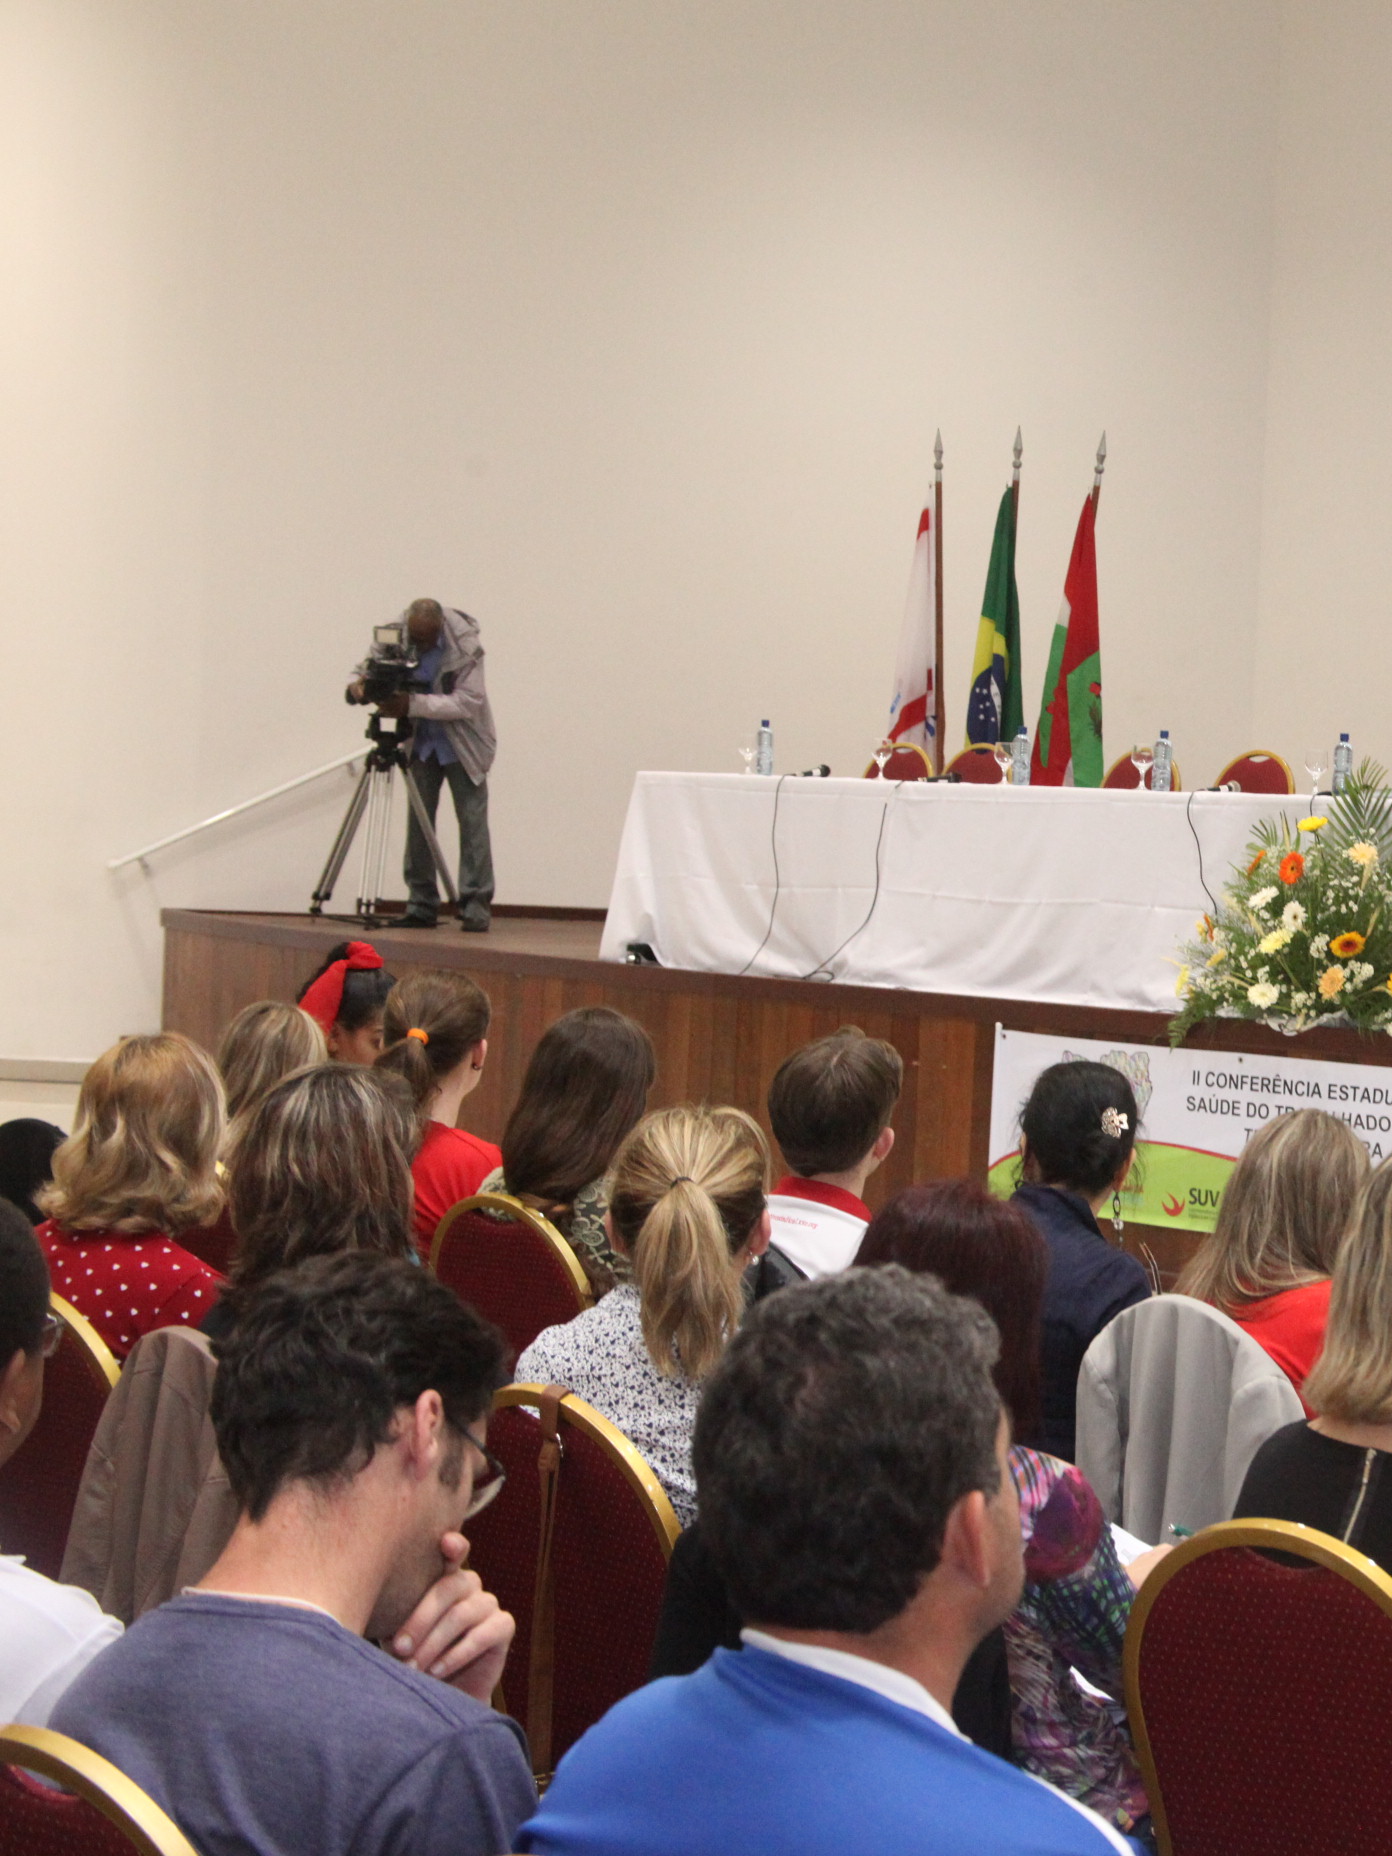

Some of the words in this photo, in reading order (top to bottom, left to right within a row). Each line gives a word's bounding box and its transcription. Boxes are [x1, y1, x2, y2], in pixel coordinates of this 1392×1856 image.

[1192, 1070, 1200, 1086] II
[1205, 1071, 1322, 1099] CONFERÊNCIA
[1186, 1094, 1241, 1117] SAÚDE
[1246, 1102, 1270, 1119] DO
